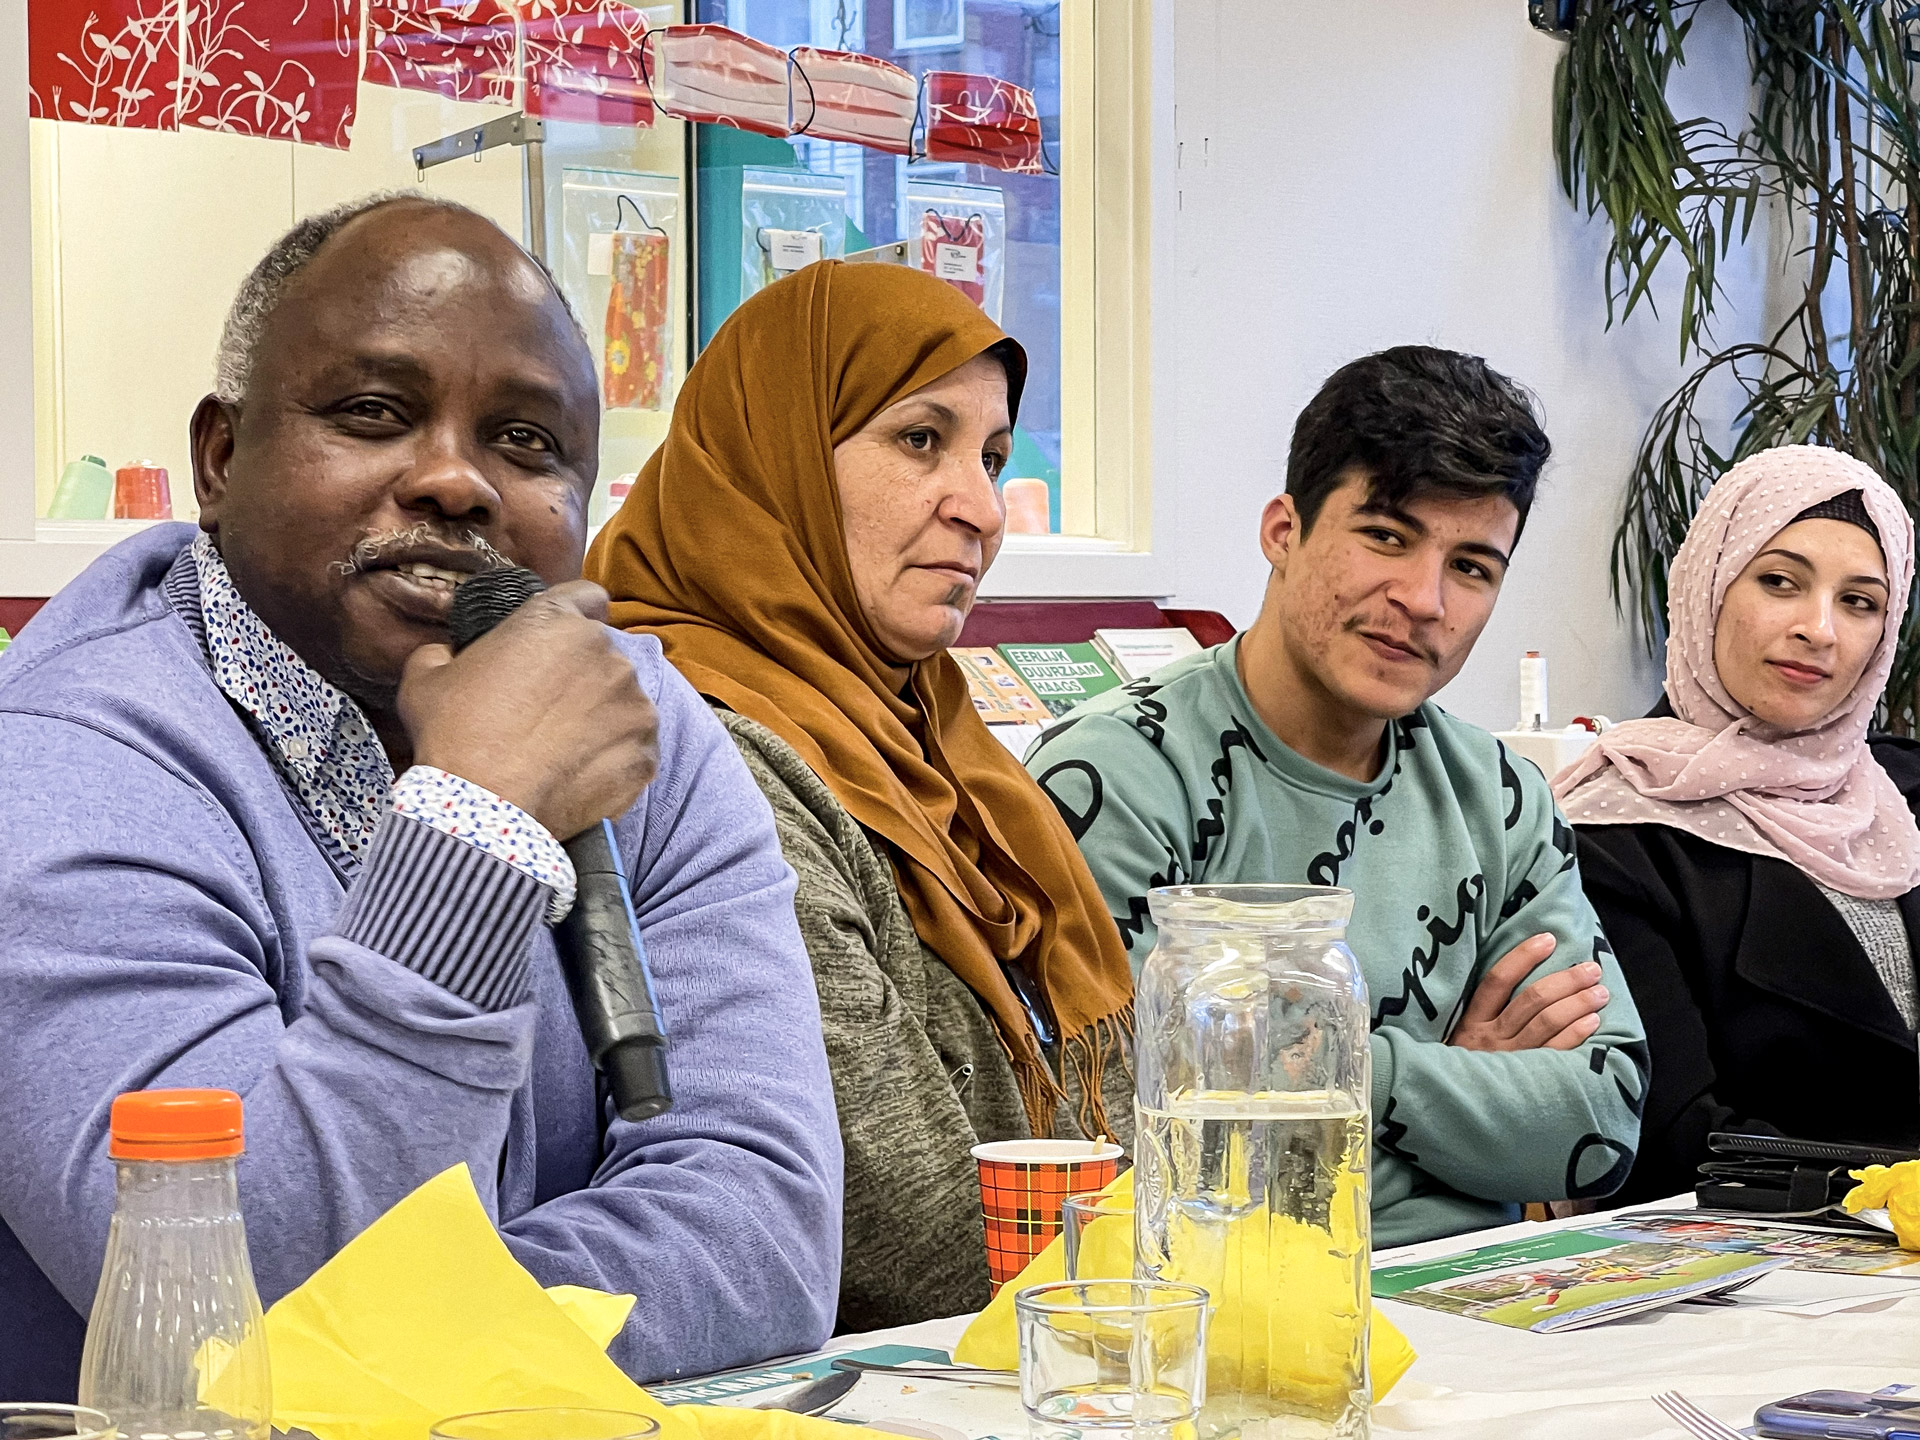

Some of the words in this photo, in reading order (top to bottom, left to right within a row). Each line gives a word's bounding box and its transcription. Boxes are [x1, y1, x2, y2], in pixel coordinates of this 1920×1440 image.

[1011, 650, 1070, 662] EERLIJK
[1022, 664, 1101, 678] DUURZAAM
[1033, 680, 1082, 693] HAAGS
[1451, 1256, 1539, 1273] Laak
